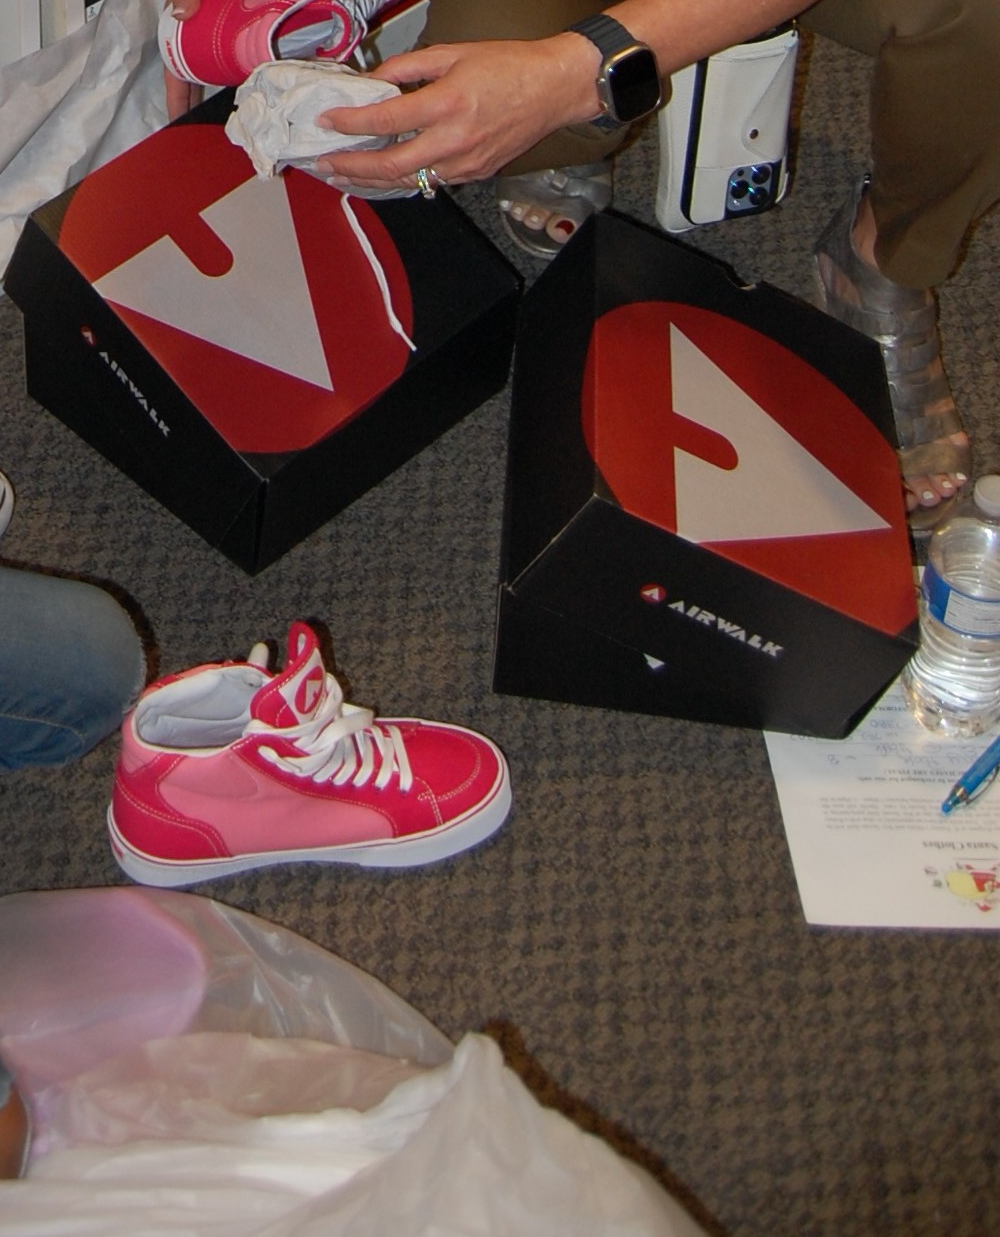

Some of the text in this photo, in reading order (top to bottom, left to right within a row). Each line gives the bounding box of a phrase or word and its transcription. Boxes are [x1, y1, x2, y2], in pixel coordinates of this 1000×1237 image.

[99, 352, 171, 438] AIRWALK
[667, 600, 785, 657] AIRWALK
[922, 840, 998, 850] Santa Clothes
